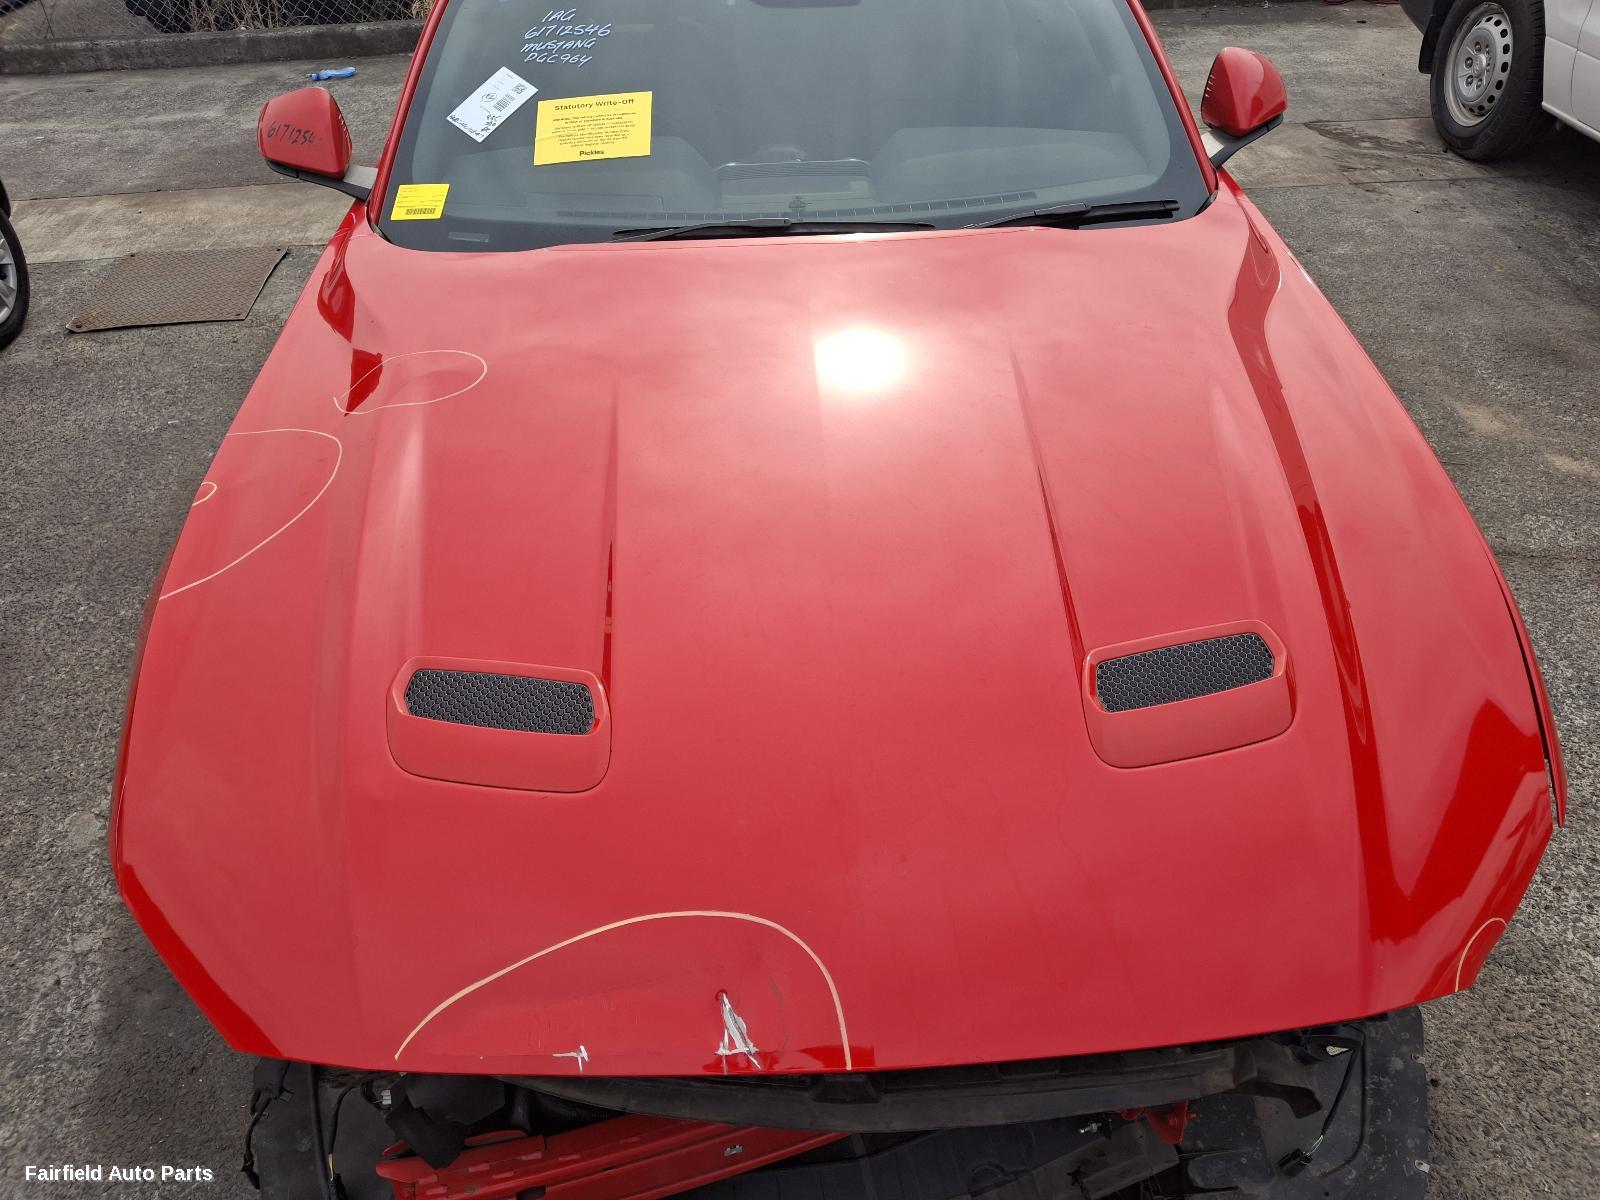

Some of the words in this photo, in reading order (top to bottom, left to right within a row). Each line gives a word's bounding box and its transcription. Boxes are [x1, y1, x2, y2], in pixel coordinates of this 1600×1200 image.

[525, 24, 612, 39] 61712546
[555, 102, 594, 111] Statutory
[595, 98, 635, 107] Write-Off
